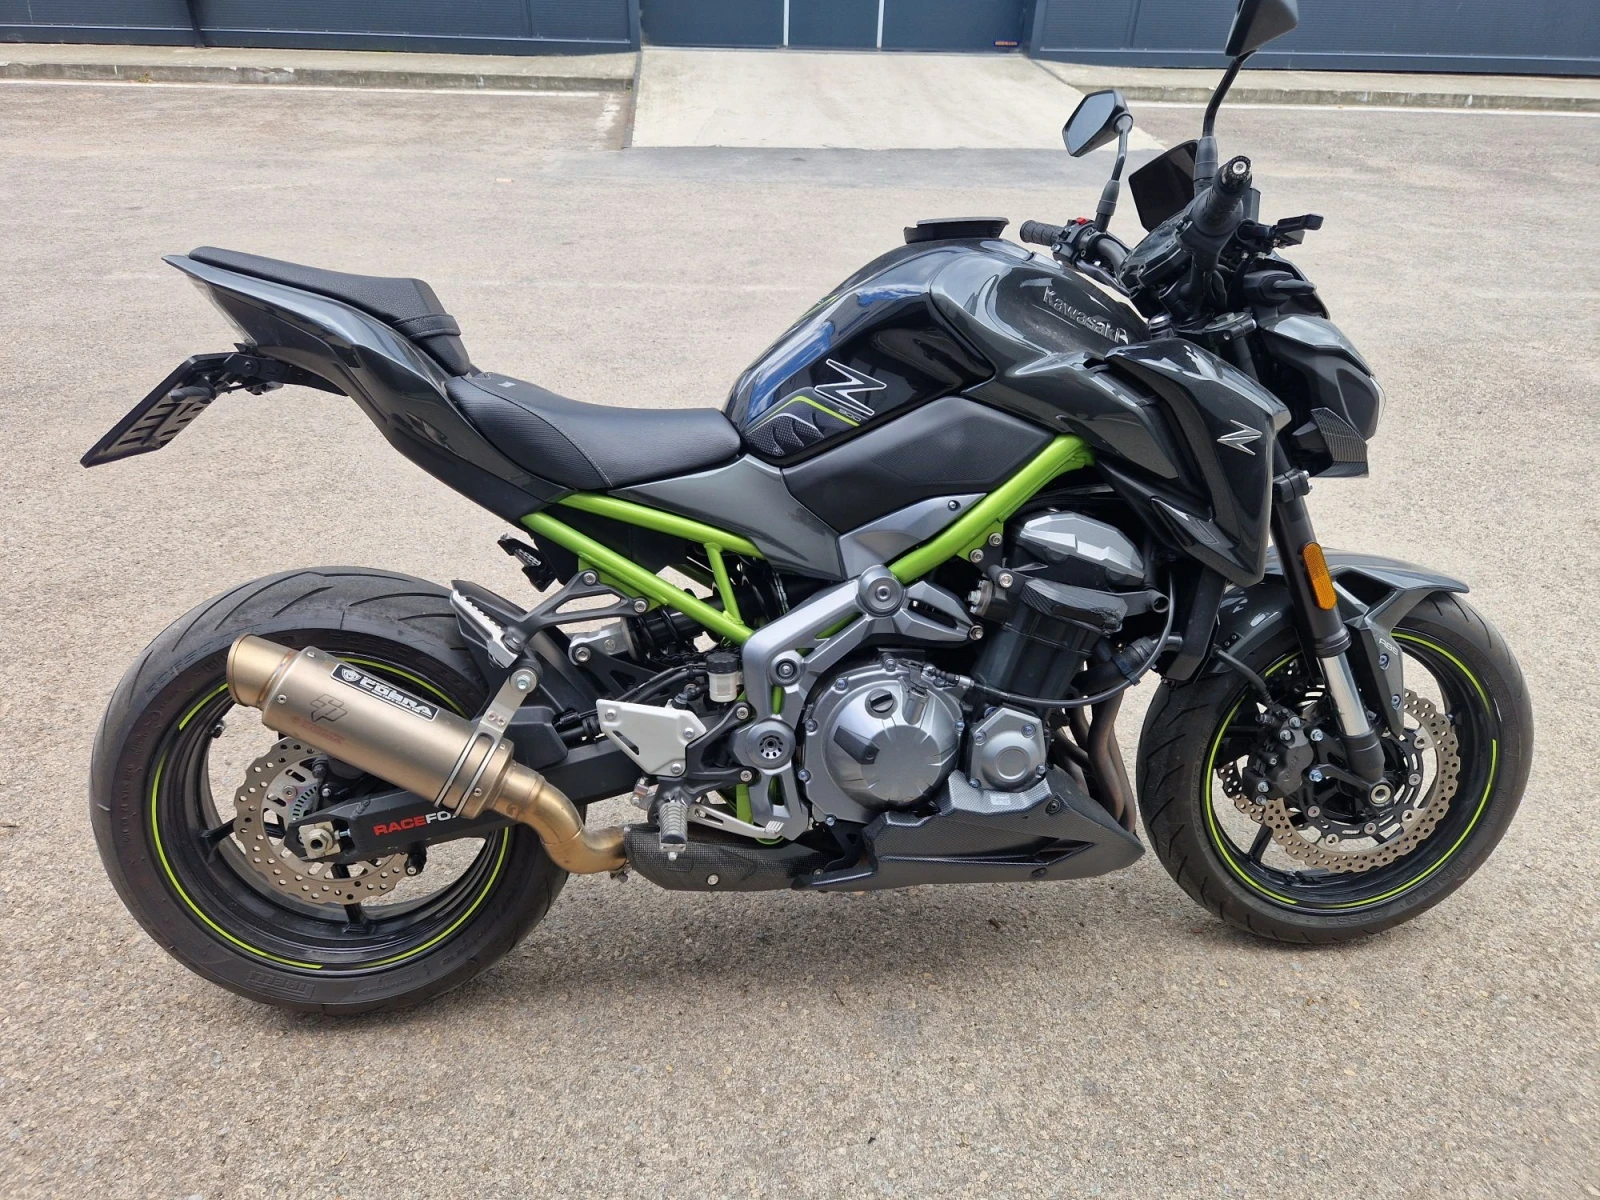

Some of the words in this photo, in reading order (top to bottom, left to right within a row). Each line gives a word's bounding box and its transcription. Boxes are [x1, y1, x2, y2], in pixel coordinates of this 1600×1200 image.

[1042, 285, 1121, 343] Kawasaki
[814, 358, 887, 416] Z
[1216, 419, 1263, 456] Z
[1379, 638, 1399, 656] ABS
[359, 676, 433, 719] COBRA
[373, 810, 458, 836] RACEFO
